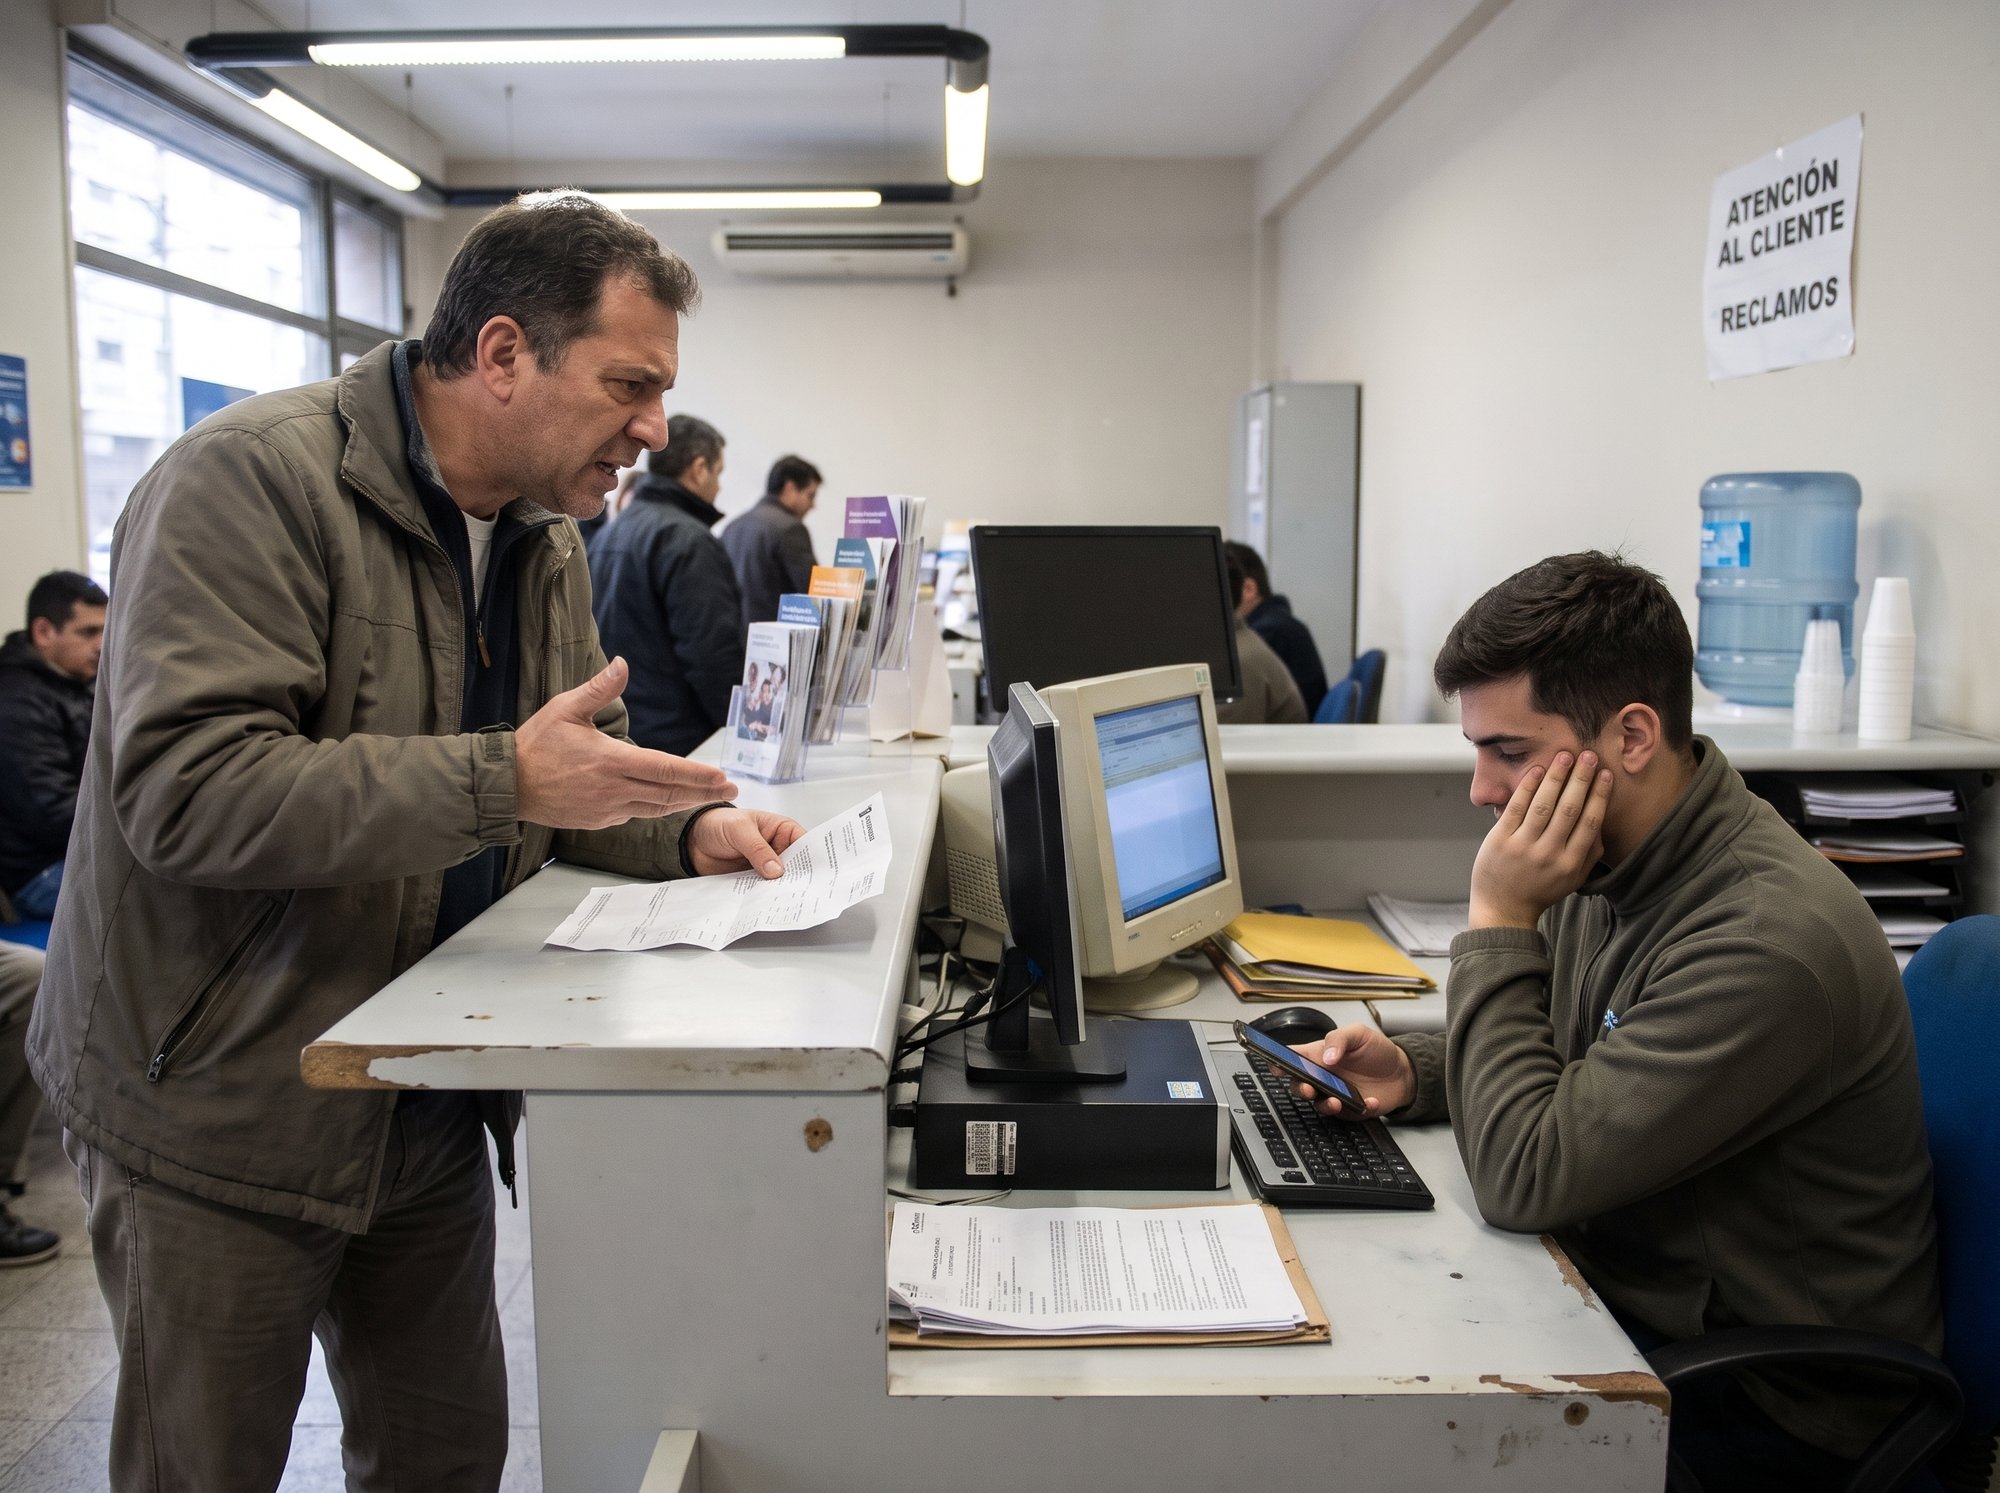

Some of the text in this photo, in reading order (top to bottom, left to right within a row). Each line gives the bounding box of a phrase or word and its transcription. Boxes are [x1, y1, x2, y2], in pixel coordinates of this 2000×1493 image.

[1727, 158, 1838, 229] ATENCIÓN
[1718, 200, 1844, 268] AL CLIENTE
[1722, 277, 1838, 333] RECLAMOS
